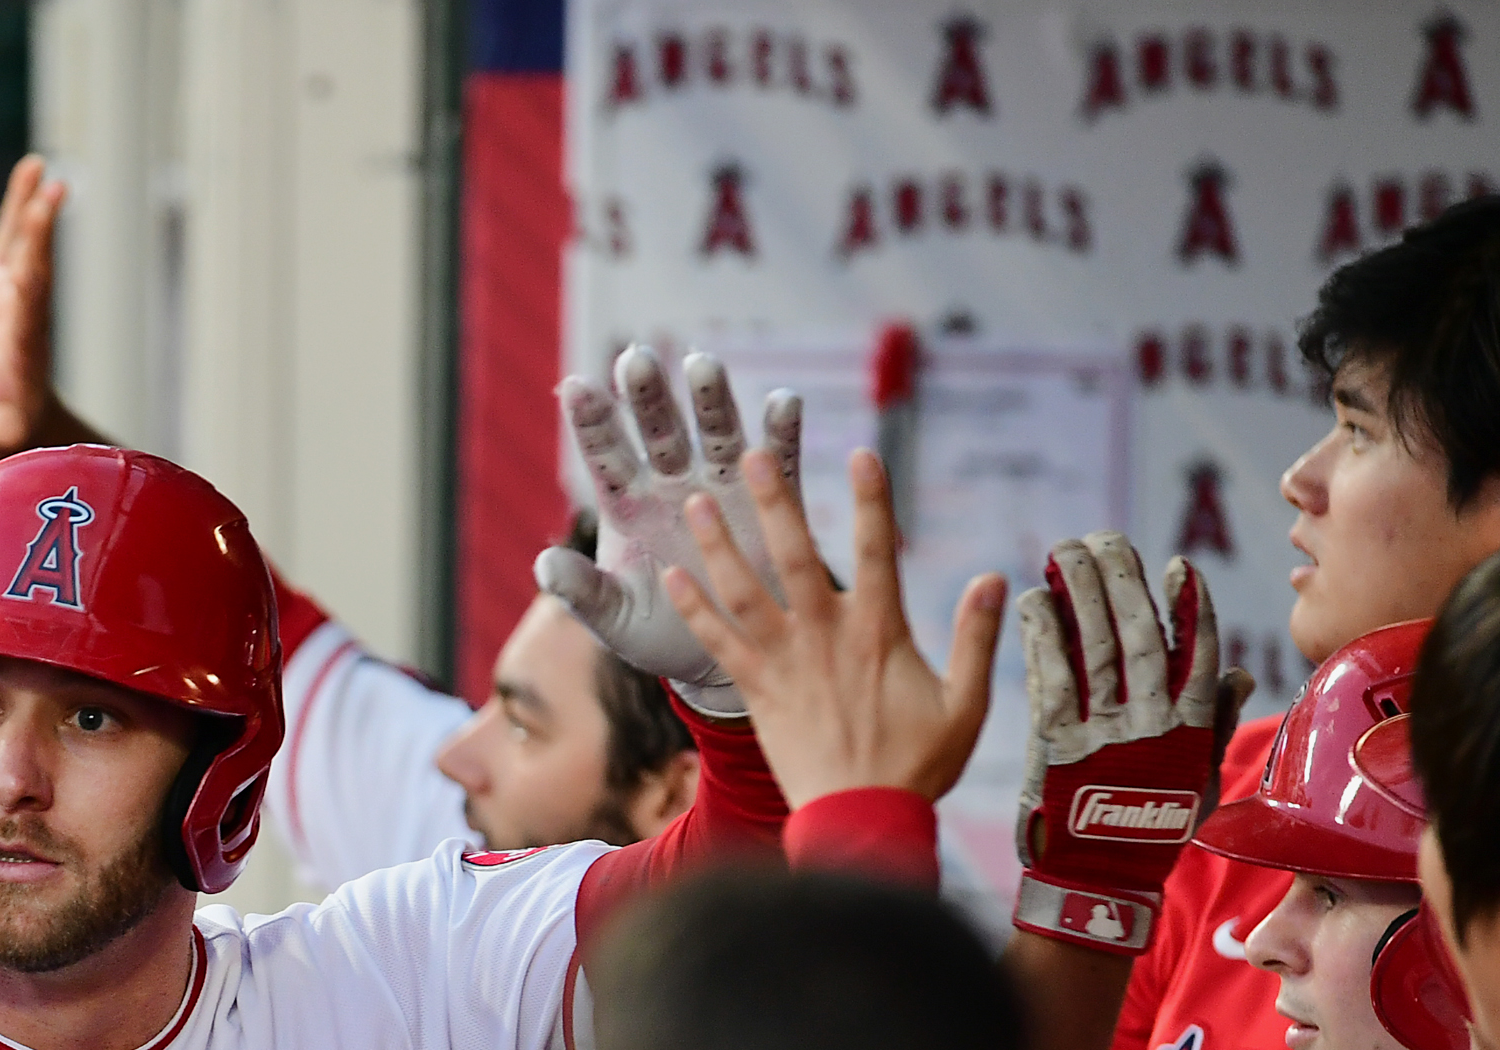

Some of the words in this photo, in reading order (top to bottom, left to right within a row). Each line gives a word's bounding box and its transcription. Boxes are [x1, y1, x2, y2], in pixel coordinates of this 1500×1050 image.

[598, 25, 858, 124] ANGELS
[1078, 30, 1340, 125] ANGELS
[836, 170, 1093, 258] ANGELS
[2, 486, 138, 612] A
